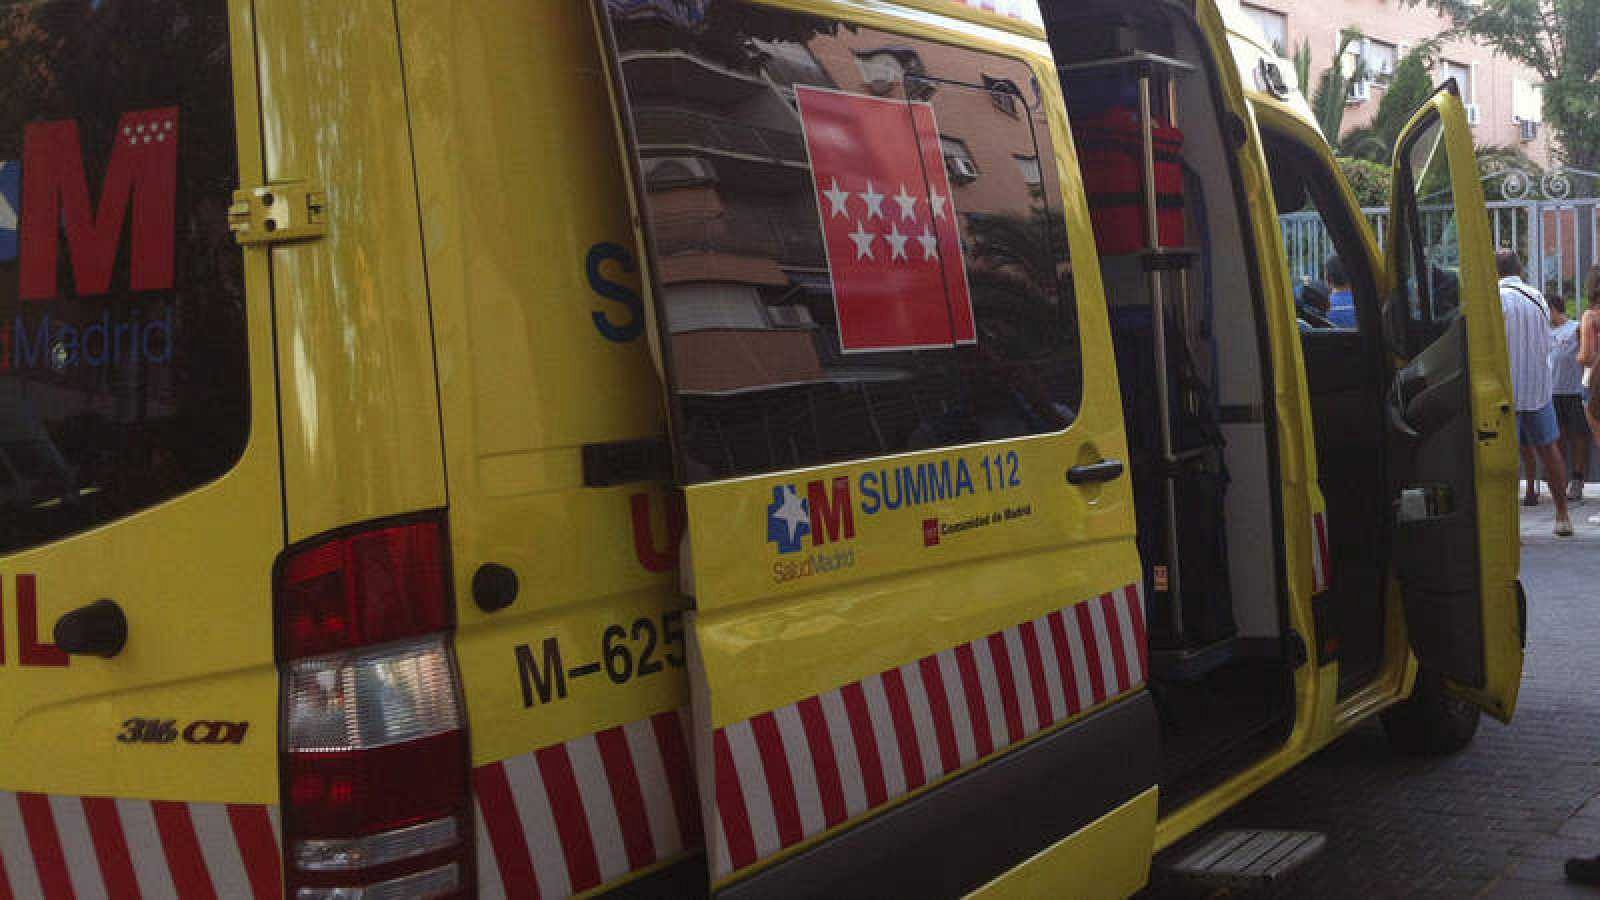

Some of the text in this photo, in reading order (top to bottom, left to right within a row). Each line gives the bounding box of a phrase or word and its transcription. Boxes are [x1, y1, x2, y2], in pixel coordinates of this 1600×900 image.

[18, 105, 179, 299] M
[807, 475, 856, 546] M
[859, 450, 1020, 515] SUMMA 112
[117, 718, 249, 744] 316 CDI
